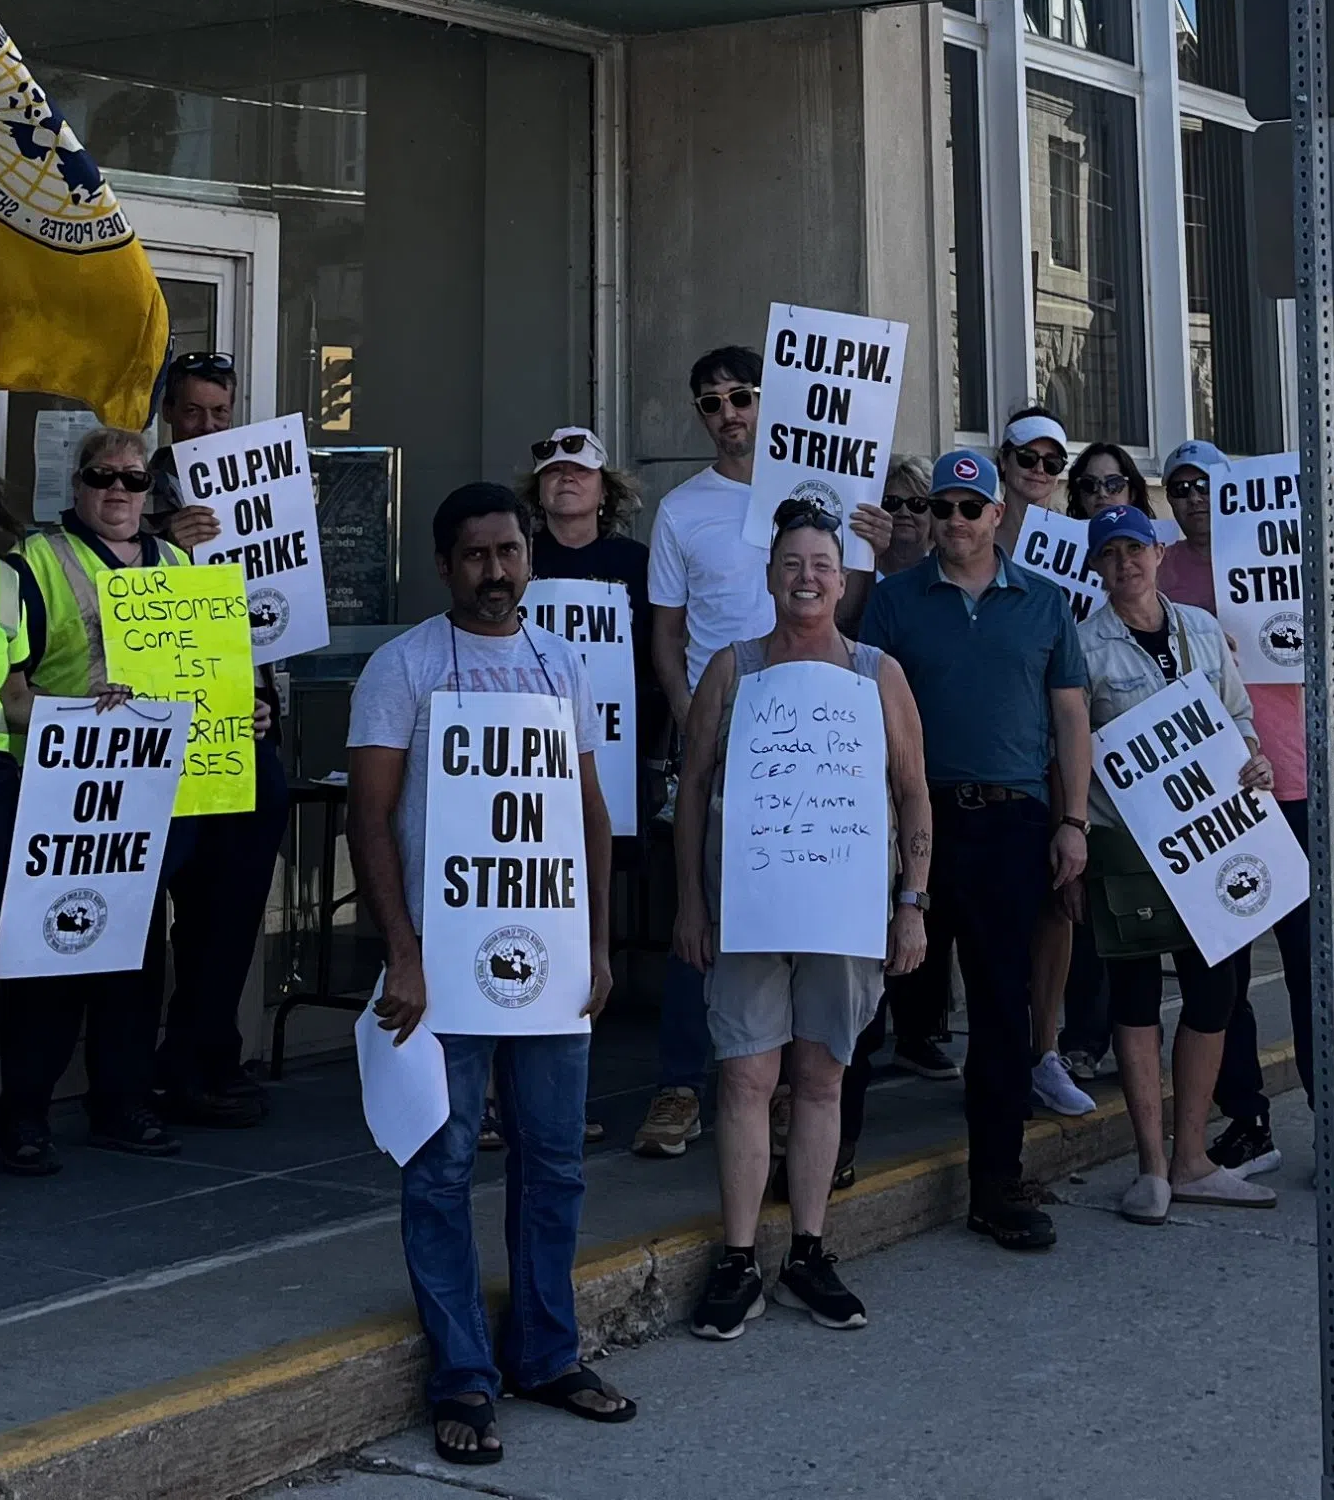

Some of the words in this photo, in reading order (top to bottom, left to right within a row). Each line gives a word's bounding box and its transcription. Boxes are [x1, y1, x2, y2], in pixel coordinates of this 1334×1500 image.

[774, 329, 892, 384] C.U.P.W.
[806, 383, 851, 426] ON
[189, 440, 300, 499] C.U.P.W.
[769, 423, 878, 479] STRIKE
[234, 493, 273, 536] ON
[1257, 519, 1301, 557] ON
[108, 570, 173, 598] OUR
[114, 596, 247, 621] CUSTOMERS
[174, 654, 221, 680] 1ST
[749, 696, 798, 734] Why
[812, 702, 857, 723] does
[38, 724, 172, 769] C.U.P.W.
[442, 725, 573, 779] C.U.P.W.
[750, 737, 817, 754] Canada
[827, 731, 863, 754] Post
[1103, 698, 1224, 789] C.U.P.W.
[750, 762, 797, 779] CEO
[817, 763, 866, 778] MAKE
[1163, 760, 1216, 812] ON
[73, 780, 124, 823] ON
[492, 791, 543, 843] ON
[801, 824, 815, 834] I
[830, 825, 872, 836] WORK
[1158, 787, 1268, 874] STRIKE
[25, 832, 151, 877] STRIKE
[749, 847, 770, 871] 3
[444, 855, 575, 908] STRIKE
